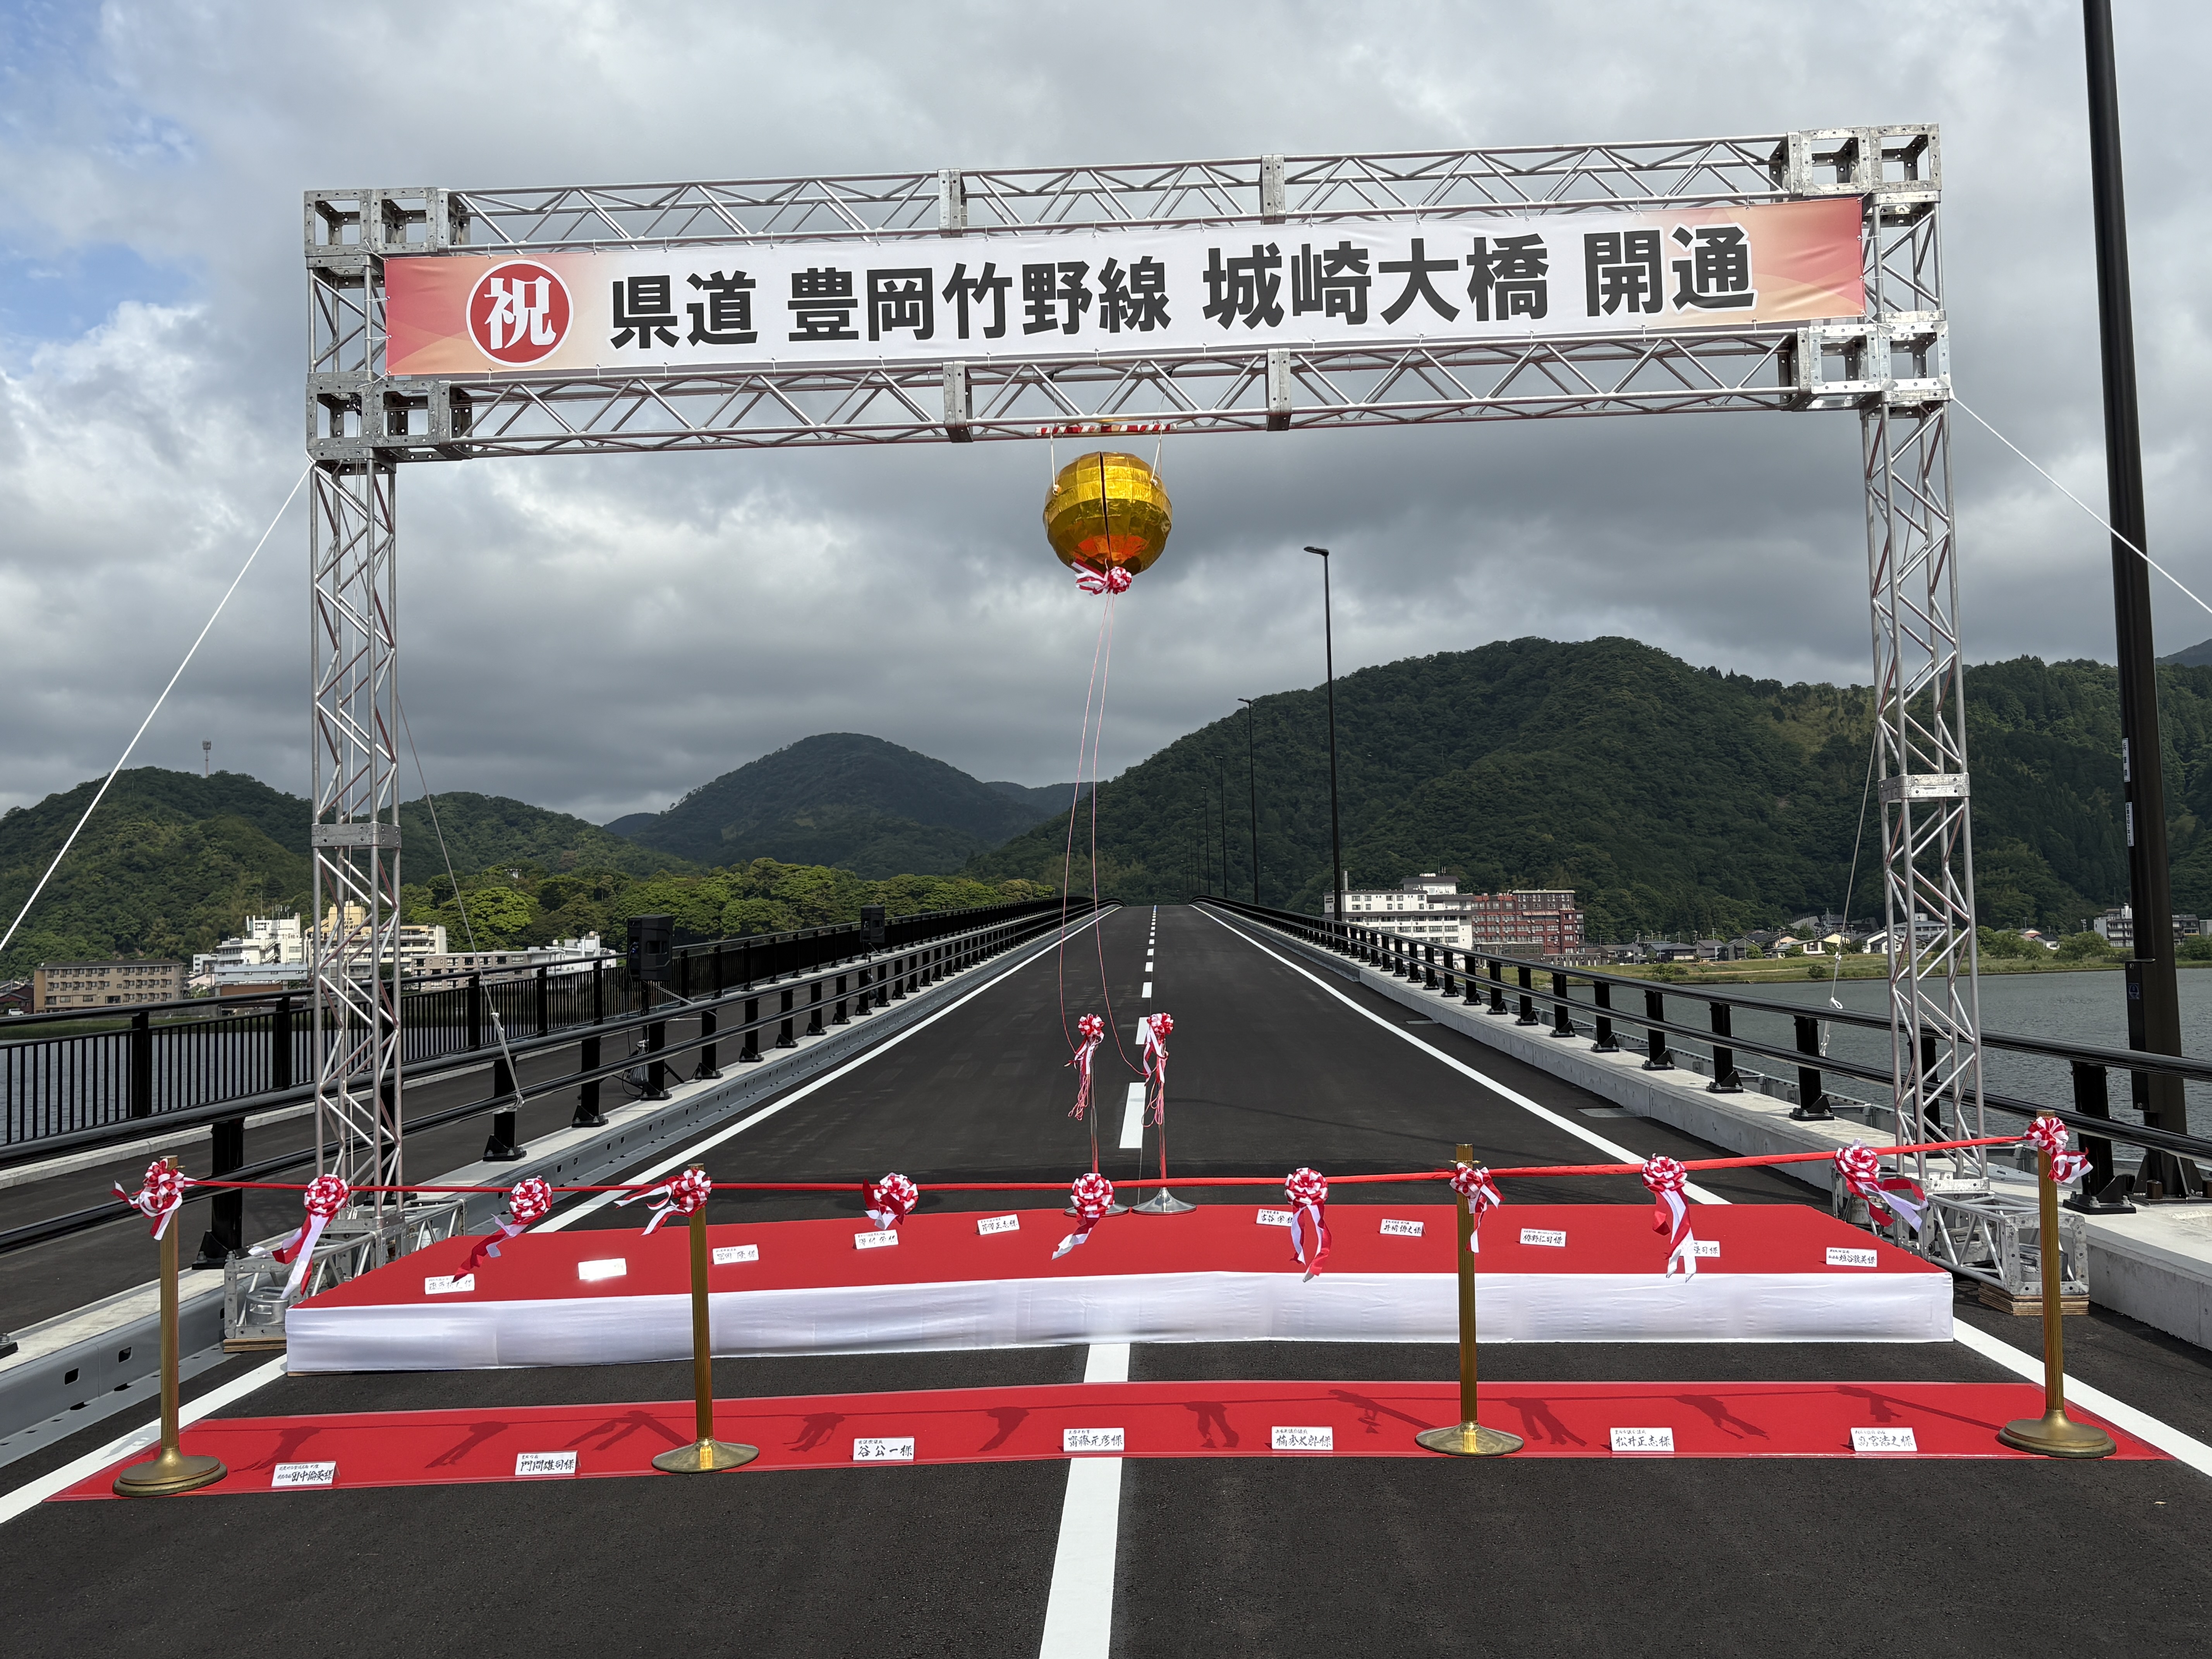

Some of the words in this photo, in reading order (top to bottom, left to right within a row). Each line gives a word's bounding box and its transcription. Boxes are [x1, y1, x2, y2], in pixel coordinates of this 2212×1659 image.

[484, 275, 556, 350] 祝
[611, 270, 758, 349] 県道
[788, 256, 1171, 342] 豊岡竹野線
[1202, 233, 1549, 330] 城崎大橋
[1584, 227, 1754, 316] 開通
[1616, 1435, 1671, 1447] 松井正志様
